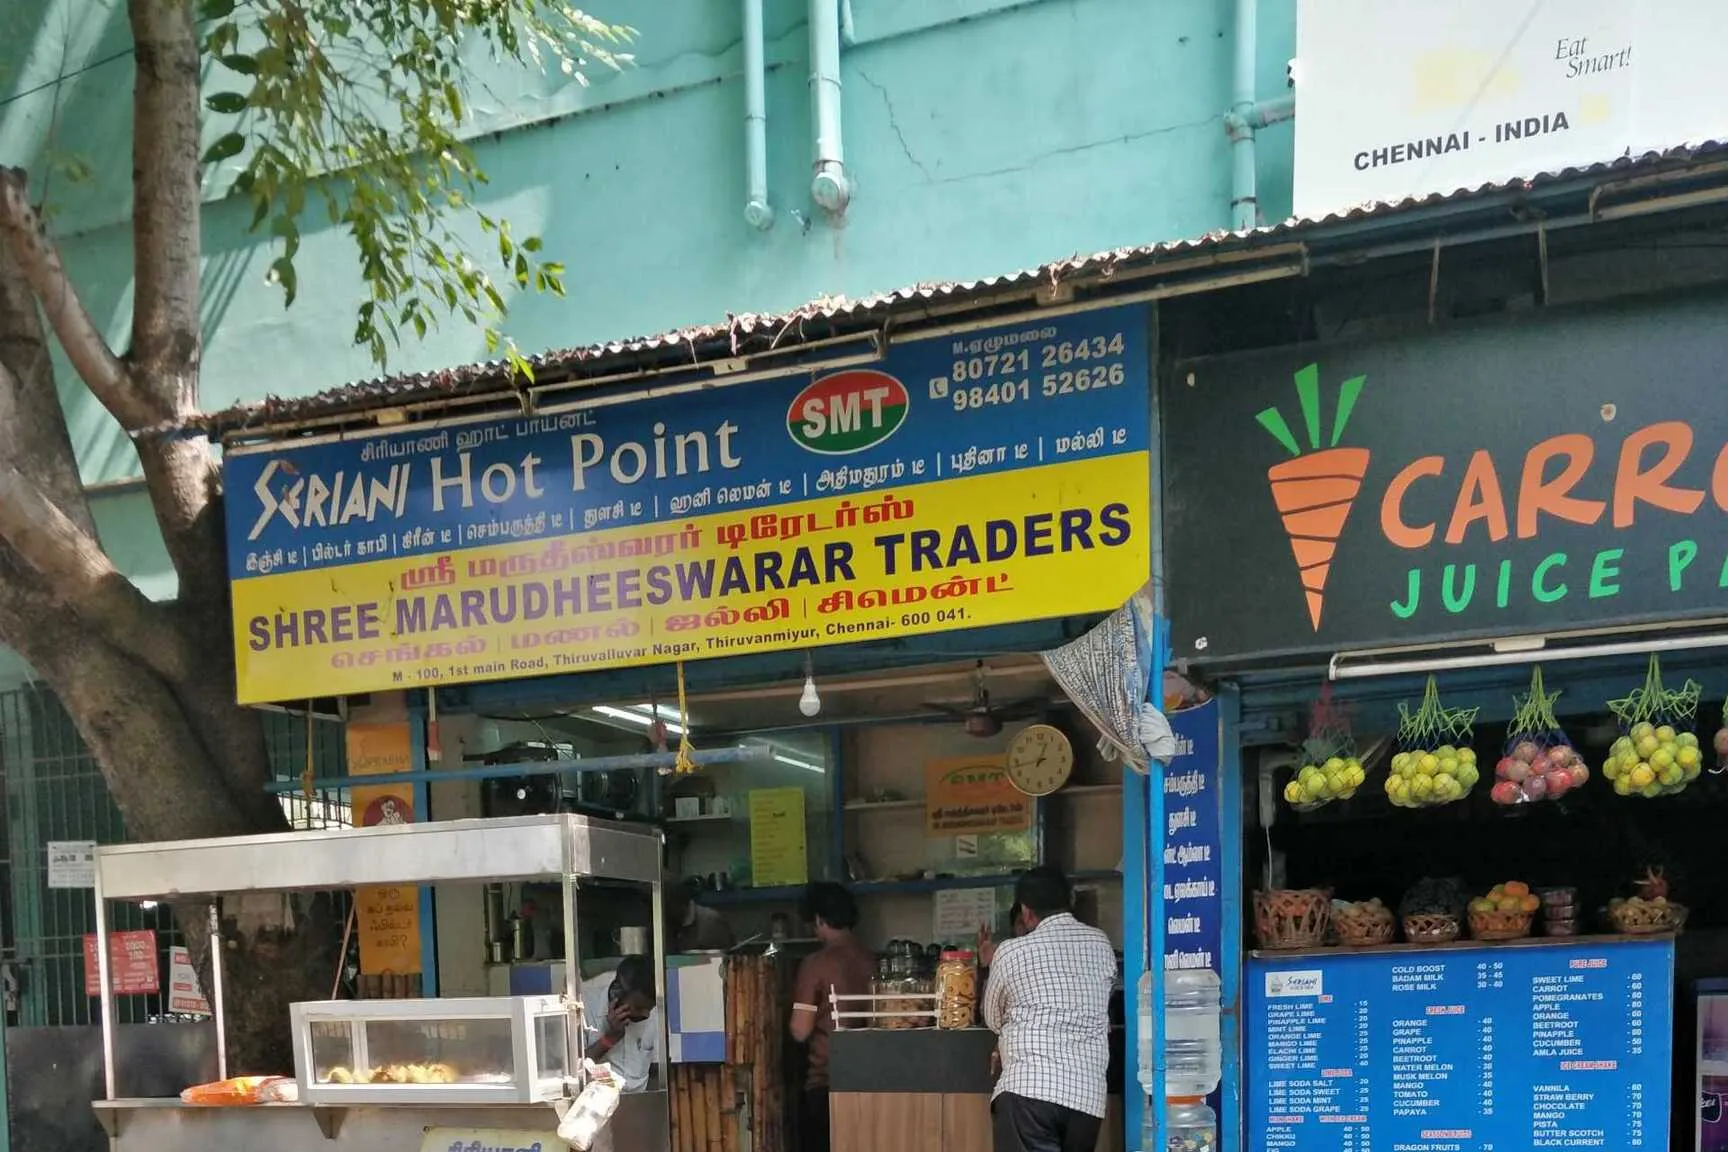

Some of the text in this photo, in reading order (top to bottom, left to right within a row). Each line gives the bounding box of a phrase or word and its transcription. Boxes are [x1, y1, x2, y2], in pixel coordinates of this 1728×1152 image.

[1556, 37, 1586, 60] Eat
[1566, 46, 1631, 78] Smart!
[1354, 131, 1469, 171] CHENNAI
[1496, 112, 1569, 143] INDIA
[953, 332, 1124, 382] 80721 26434
[802, 386, 889, 438] SMT
[953, 363, 1124, 411] 98401 52626
[456, 424, 509, 449] ஹாட்
[431, 451, 544, 512] Hot
[570, 419, 742, 491] Point
[1380, 421, 1728, 549] CARR
[288, 551, 298, 564] டீ
[357, 533, 387, 556] காபி
[441, 528, 451, 542] டீ
[552, 513, 563, 527] டீ
[584, 500, 624, 529] துளசி
[631, 501, 642, 516] டீ
[717, 479, 772, 503] லெமன்
[779, 480, 791, 495] டீ
[816, 459, 904, 491] அதிமதுரம்
[912, 458, 925, 475] டீ
[951, 446, 1006, 472] புதினா
[1015, 443, 1028, 459] டீ
[1056, 427, 1104, 454] மல்லி
[1112, 427, 1126, 445] டீ
[717, 495, 915, 549] டிரேடர்ஸ்
[249, 503, 1132, 652] SHREE MARUDHEESWARAR TRADERS
[1390, 547, 1624, 620] JUICE
[392, 671, 403, 682] M
[417, 666, 444, 680] 100,
[448, 664, 468, 678] 1st
[473, 660, 505, 674] main
[510, 656, 548, 672] Road,
[553, 646, 647, 665] Thiruvalluvar
[653, 640, 701, 658] Nagar,
[706, 625, 820, 650] Thiruvanmiyur,
[901, 610, 931, 627] 600
[936, 606, 972, 623] 041.
[1393, 1028, 1421, 1036] GRAPE
